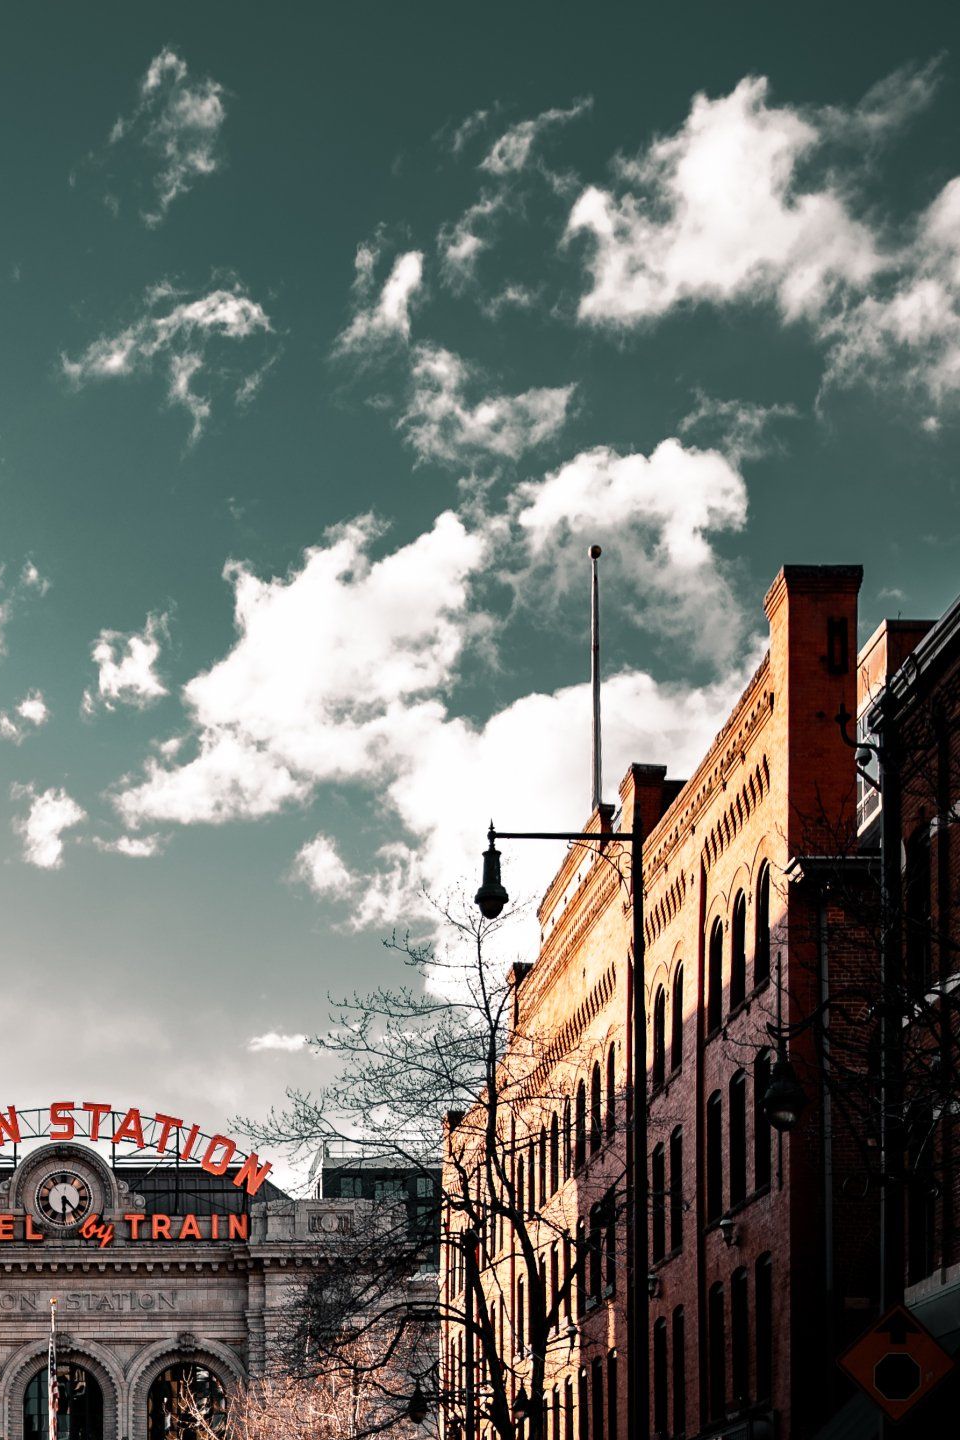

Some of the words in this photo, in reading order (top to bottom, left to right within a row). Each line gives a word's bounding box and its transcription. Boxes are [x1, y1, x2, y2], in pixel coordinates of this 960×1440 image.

[50, 1102, 273, 1196] STATION
[79, 1213, 114, 1247] by
[124, 1213, 247, 1240] TRAIN
[66, 1291, 177, 1311] STATION
